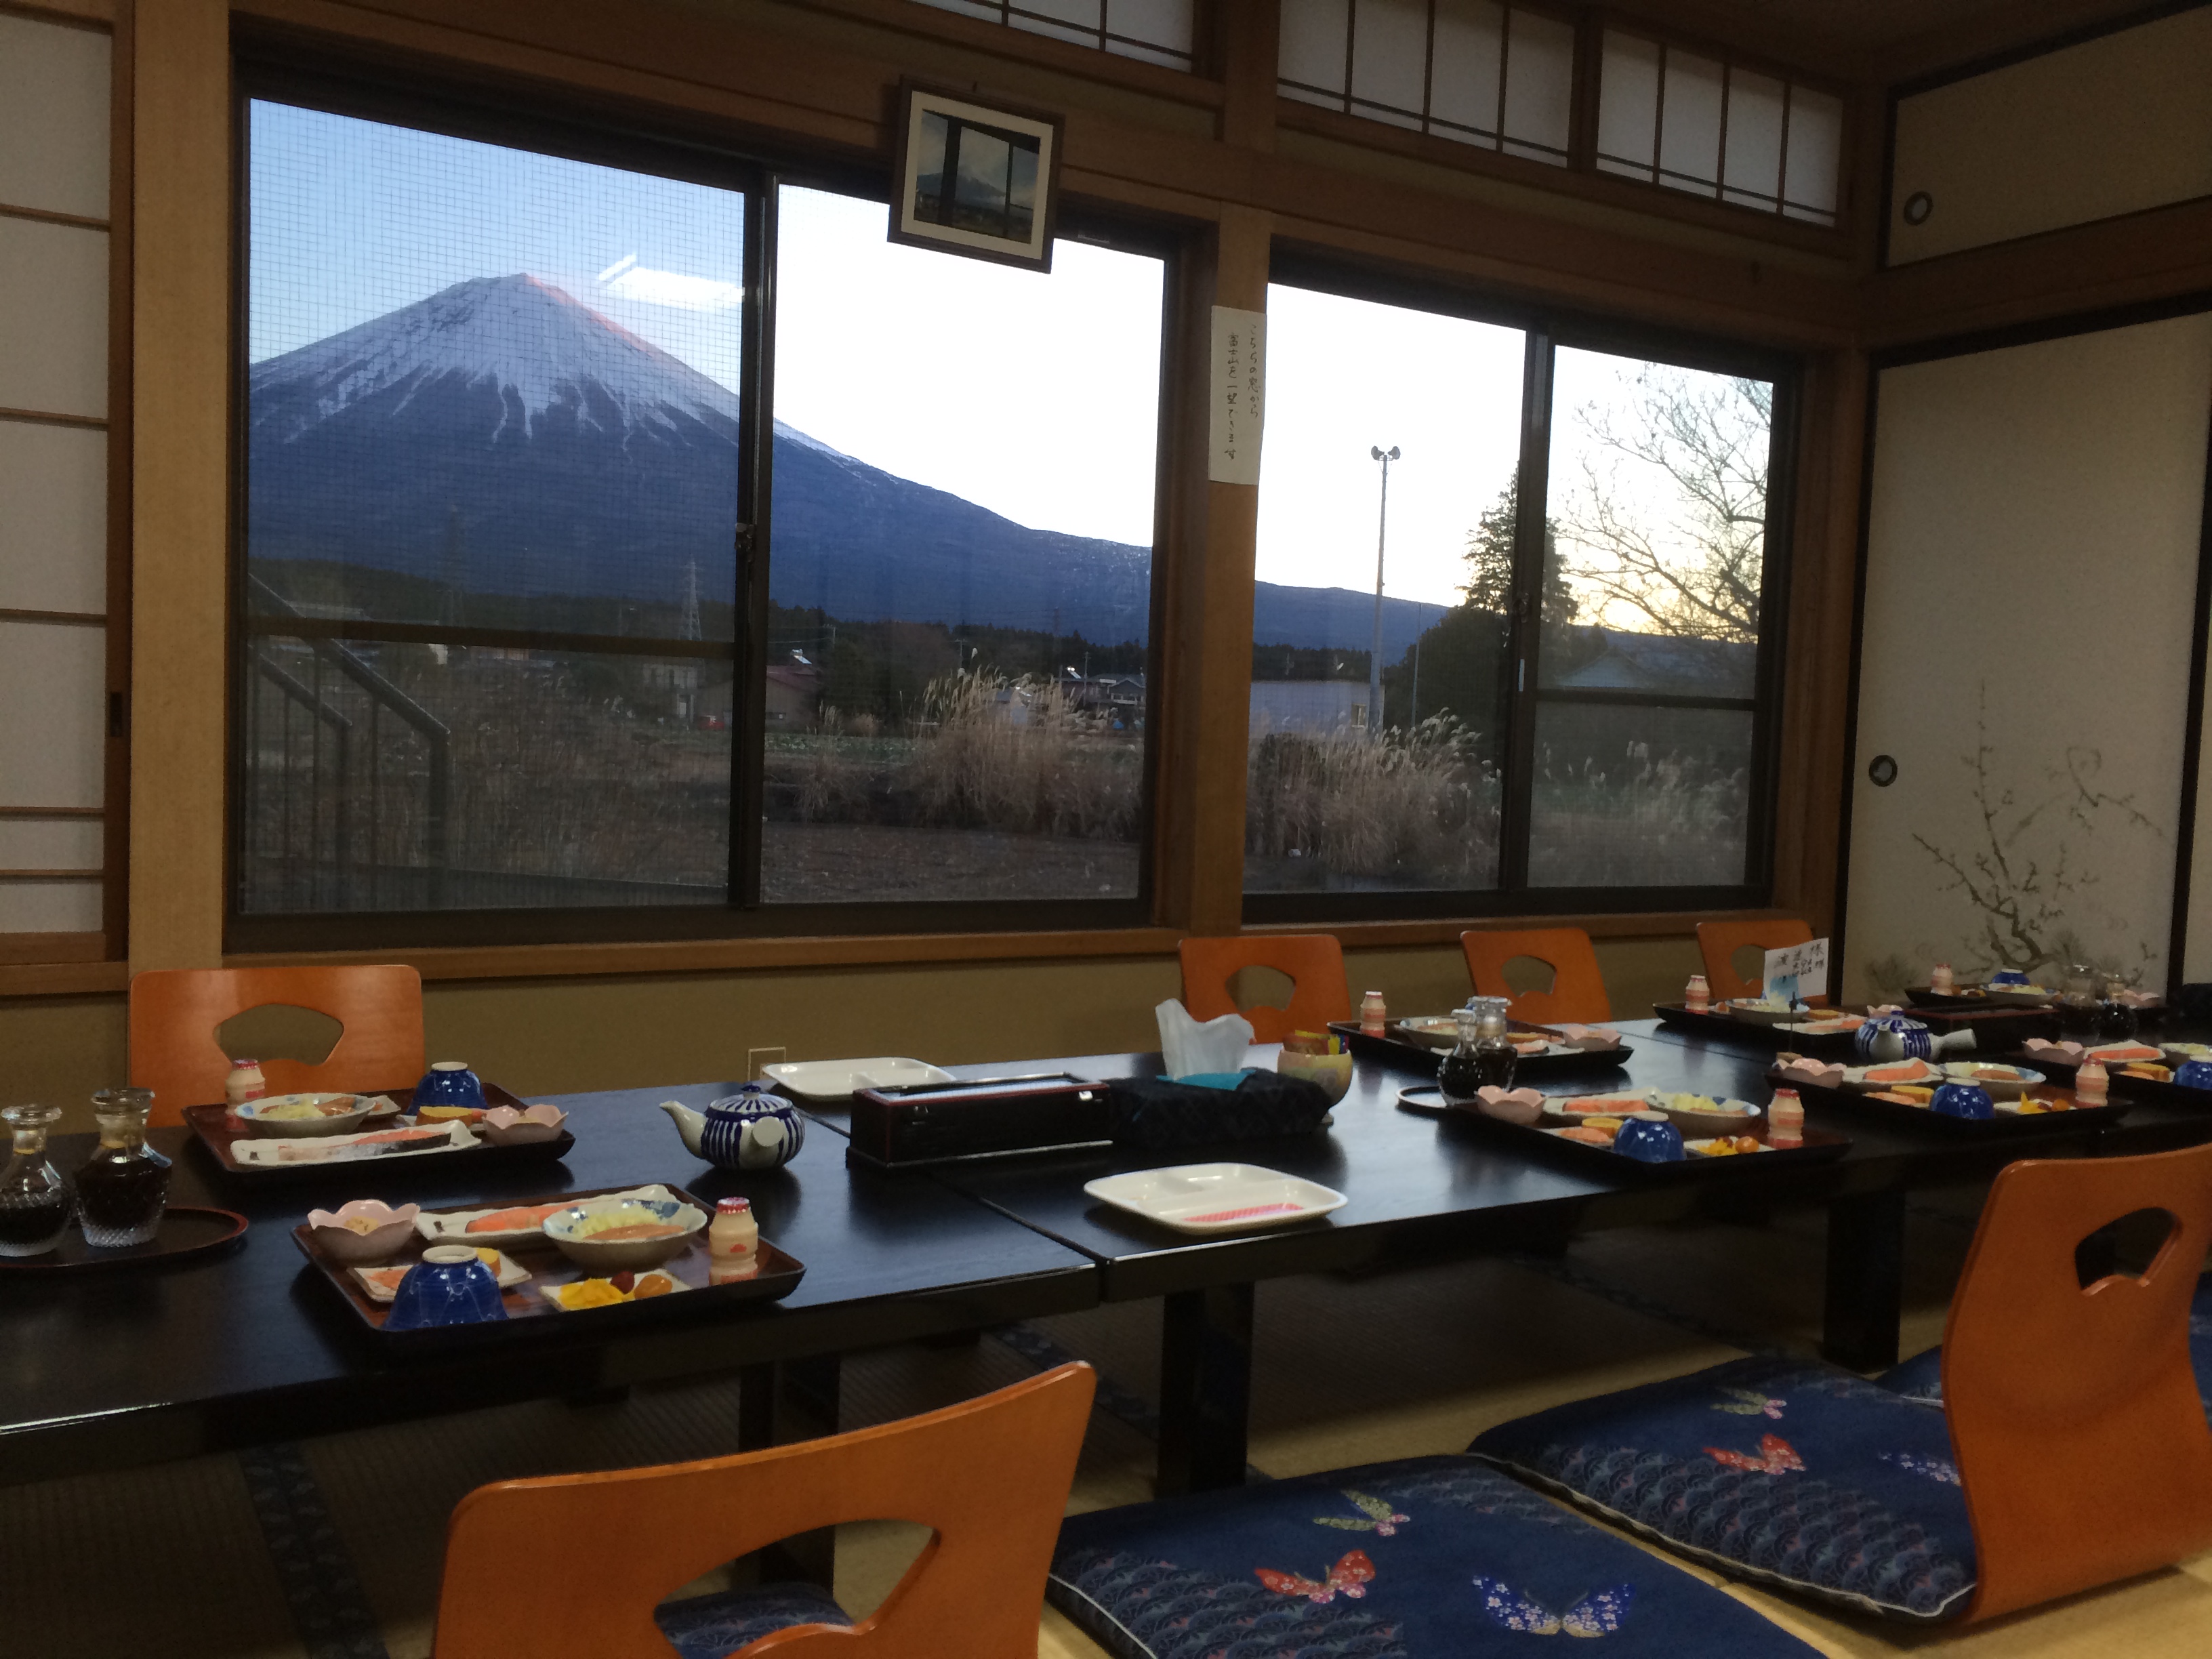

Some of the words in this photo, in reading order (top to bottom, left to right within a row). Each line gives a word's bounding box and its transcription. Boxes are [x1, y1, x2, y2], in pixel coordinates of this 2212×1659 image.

[1224, 332, 1239, 460] 富士山を一望できます
